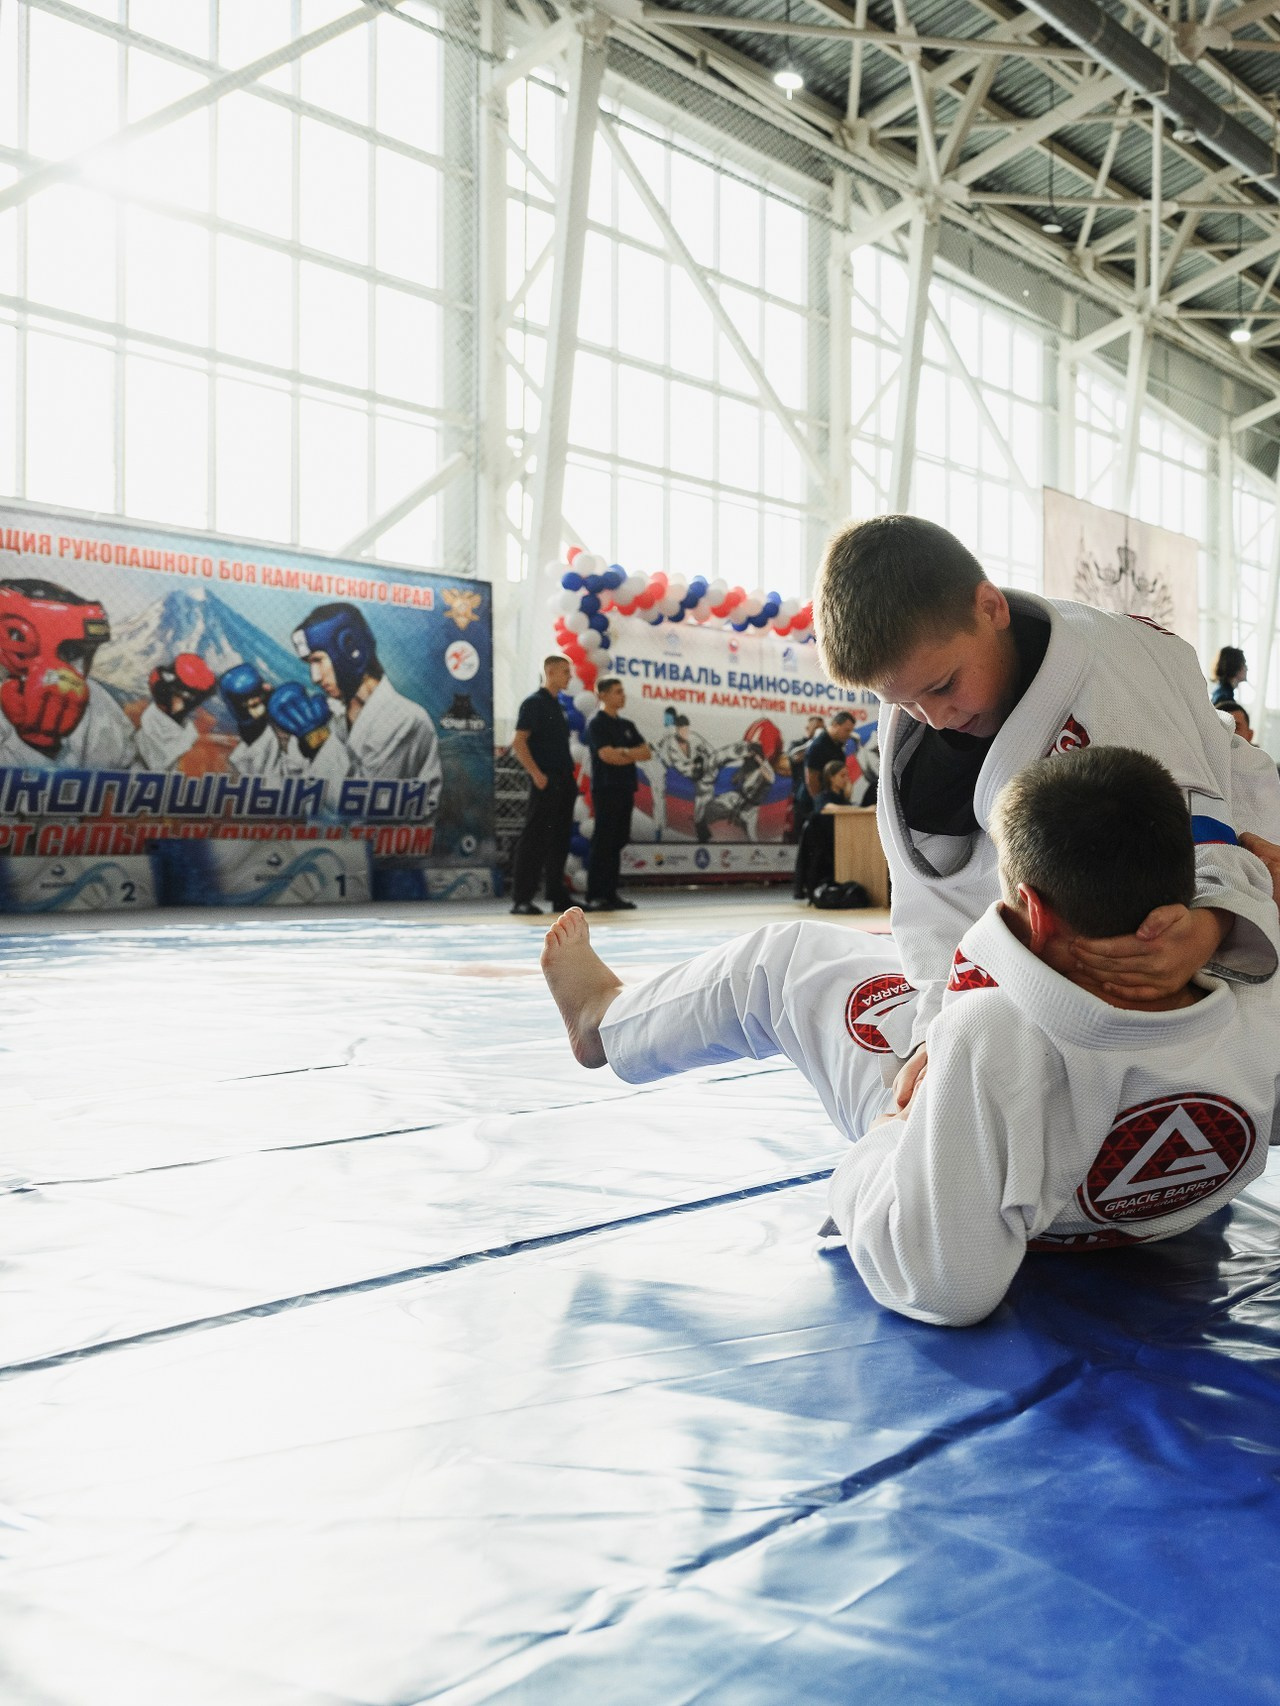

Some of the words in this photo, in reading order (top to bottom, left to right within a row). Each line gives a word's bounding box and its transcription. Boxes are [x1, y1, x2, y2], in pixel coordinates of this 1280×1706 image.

[58, 537, 213, 577] РУКОПАШНОГО
[219, 560, 256, 583] БОЯ
[261, 567, 387, 600] КАМЧАТСКОГО
[391, 584, 433, 607] КРАЯ
[608, 656, 720, 686] ЕСТИВАЛЬ
[642, 684, 705, 704] ПАМЯТИ
[711, 692, 786, 713] АНАТОЛИЯ
[791, 701, 868, 721] ПАНАСКО
[0, 767, 325, 817] КОПАШНЫЙ
[121, 882, 136, 902] 2
[335, 873, 347, 897] 1
[862, 982, 911, 1006] BARRA
[1104, 1191, 1161, 1212] GRACIE
[1164, 1179, 1216, 1199] BARRA
